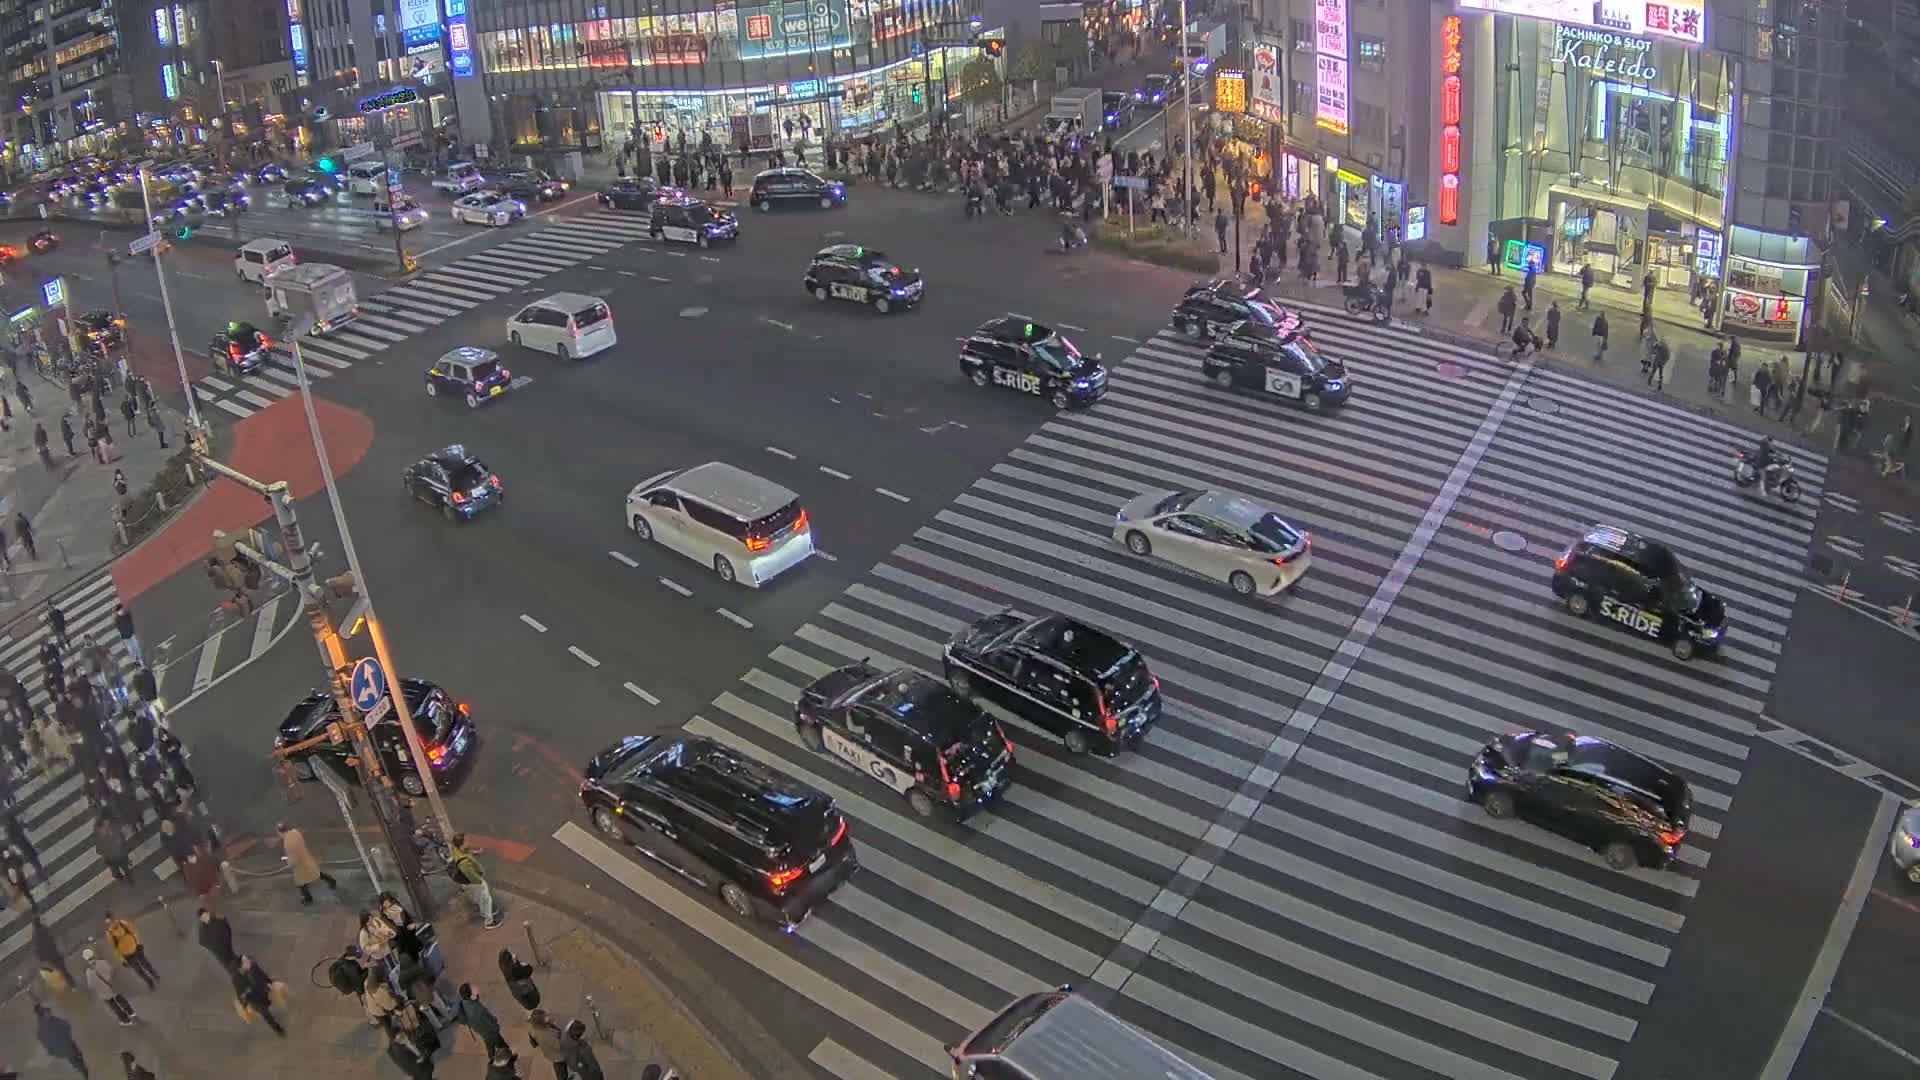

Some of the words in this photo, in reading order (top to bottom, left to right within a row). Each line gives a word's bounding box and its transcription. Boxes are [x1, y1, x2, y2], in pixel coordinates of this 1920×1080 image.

[1557, 24, 1612, 44] PACHINKO
[1613, 35, 1622, 45] &
[1624, 38, 1652, 51] SLOT
[1551, 39, 1657, 80] Kaleido
[993, 369, 1041, 396] S.RIDE
[1600, 600, 1663, 638] S.RIDE
